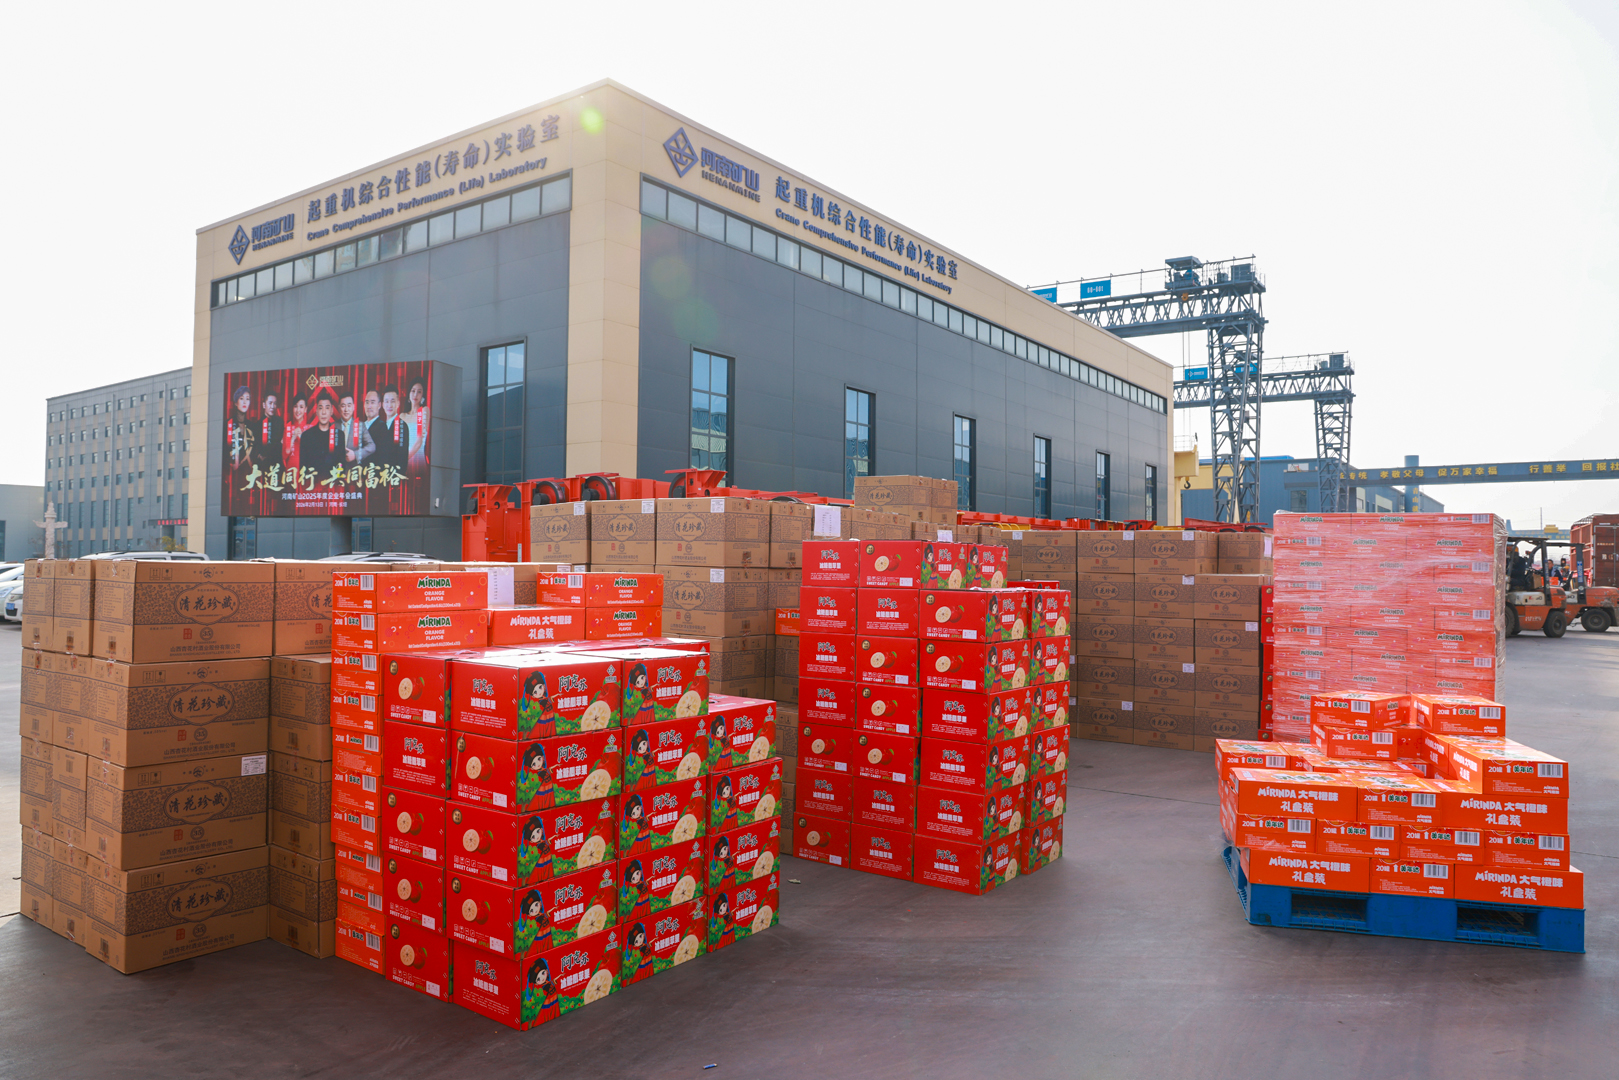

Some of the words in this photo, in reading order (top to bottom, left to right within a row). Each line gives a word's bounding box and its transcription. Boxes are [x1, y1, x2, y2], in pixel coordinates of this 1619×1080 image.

[307, 114, 560, 224] 起重机综合性能(寿命)实验室
[701, 147, 760, 192] 河南矿山
[701, 169, 761, 203] HENANMINE
[307, 227, 329, 241] Crane
[332, 206, 394, 235] Comprehensive
[397, 186, 454, 213] Performance
[458, 175, 484, 195] (Life)
[489, 156, 547, 183] Laboratory
[251, 213, 294, 243] 河南矿山
[775, 176, 958, 280] 起重机综合性能(寿命)实验室
[252, 231, 294, 251] HENANMINE
[775, 208, 800, 226] Crane
[803, 220, 859, 251] Comprehensive
[862, 245, 902, 272] Performance
[904, 263, 920, 281] (Life)
[921, 272, 952, 294] Laboratory
[240, 463, 318, 491] 大道同行
[321, 462, 409, 489] 共同富裕
[1337, 471, 1367, 480] 传统
[1380, 469, 1424, 479] 孝敬父母
[1437, 466, 1498, 477] 促万家幸福
[1529, 464, 1566, 474] 行善举
[281, 491, 363, 500] 河南矿山2025年度企业年会盛典
[821, 549, 840, 561] 阿克苏
[180, 595, 234, 612] 清花珍藏
[878, 598, 897, 610] 阿克苏
[528, 628, 555, 640] 礼盒装
[657, 666, 682, 682] 阿克苏
[473, 678, 494, 696] 阿克苏
[558, 674, 589, 692] 阿克苏
[172, 694, 228, 713] 清花珍藏
[944, 700, 965, 713] 阿克苏
[734, 715, 754, 731] 阿克苏
[404, 738, 424, 754] 阿克苏
[557, 744, 587, 763] 阿克苏
[942, 750, 964, 762] 阿克苏
[169, 791, 226, 813] 清花珍藏
[1298, 790, 1339, 802] 大气橙味
[1280, 801, 1315, 814] 礼盒装
[1504, 802, 1548, 814] 大气橙味
[555, 813, 584, 832] 阿克苏
[1485, 813, 1522, 827] 礼盒装
[480, 869, 491, 877] APPLE
[1310, 860, 1350, 872] 大气橙味
[1292, 871, 1326, 885] 礼盒装
[1519, 874, 1564, 888] 大气橙味
[171, 889, 228, 912] 清花珍藏
[1500, 886, 1537, 901] 礼盒装
[560, 950, 590, 972] 阿克苏
[475, 960, 497, 980] 阿克苏
